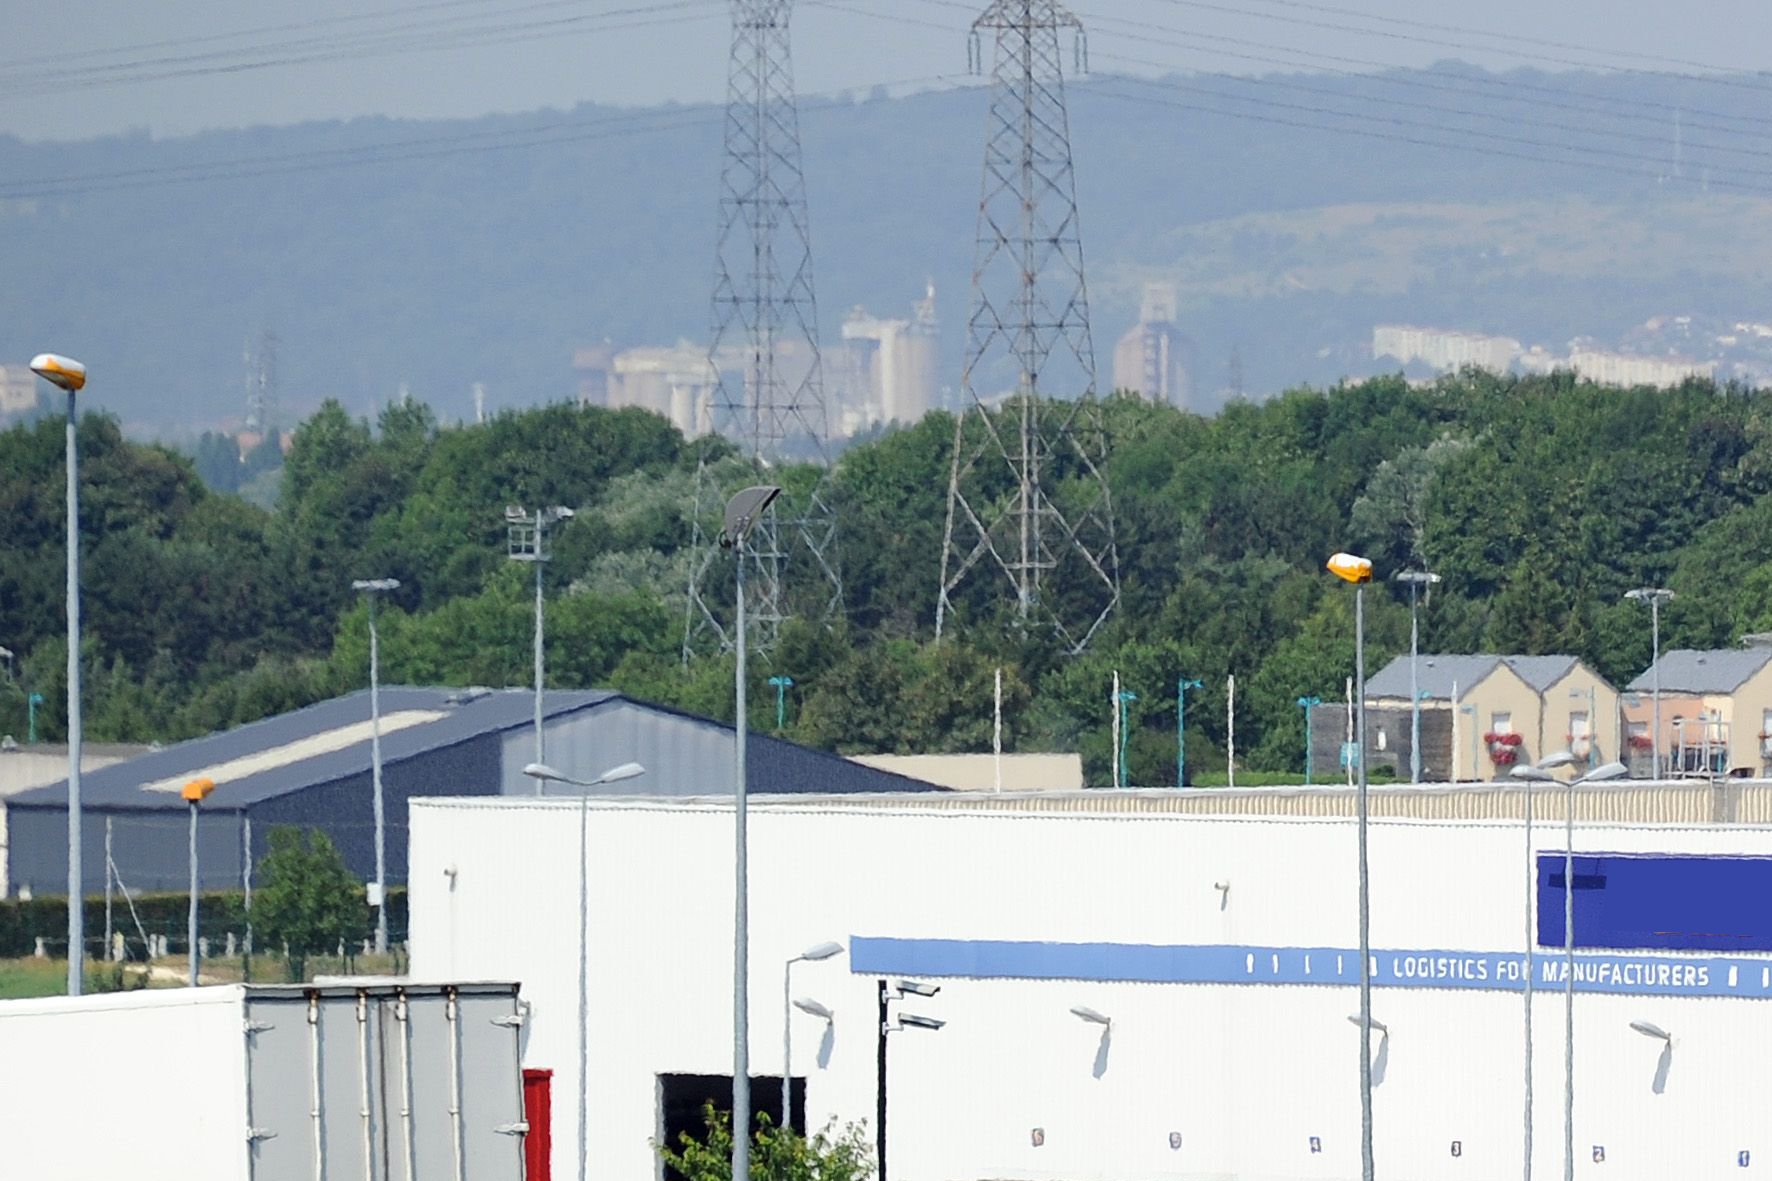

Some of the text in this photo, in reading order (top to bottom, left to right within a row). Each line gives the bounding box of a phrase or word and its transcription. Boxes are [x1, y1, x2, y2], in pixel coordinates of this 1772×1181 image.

[1393, 957, 1488, 980] LOGISTICS
[1542, 960, 1709, 986] MANUFACTURERS
[1452, 1142, 1460, 1156] 3
[1594, 1147, 1603, 1163] 2
